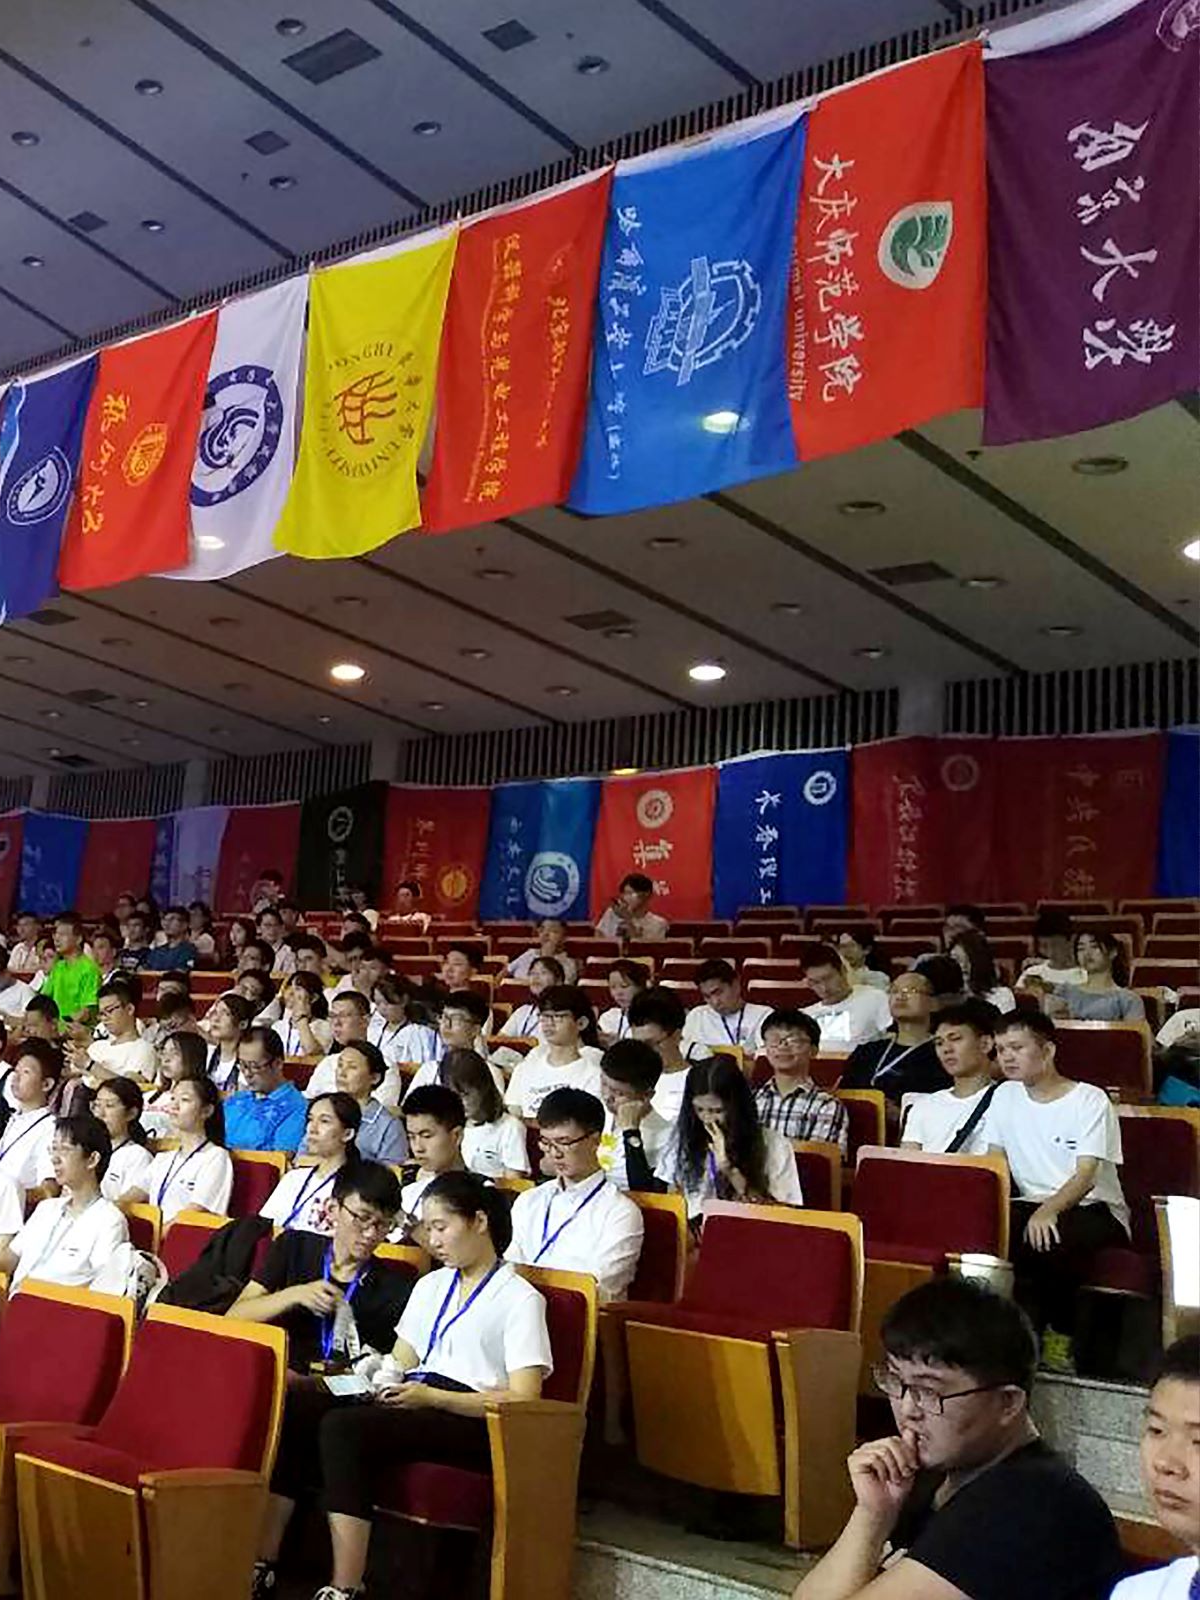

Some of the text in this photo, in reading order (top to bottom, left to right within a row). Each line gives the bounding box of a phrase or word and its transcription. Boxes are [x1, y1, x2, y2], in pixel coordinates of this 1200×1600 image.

[808, 152, 865, 402] 大庆师范学院
